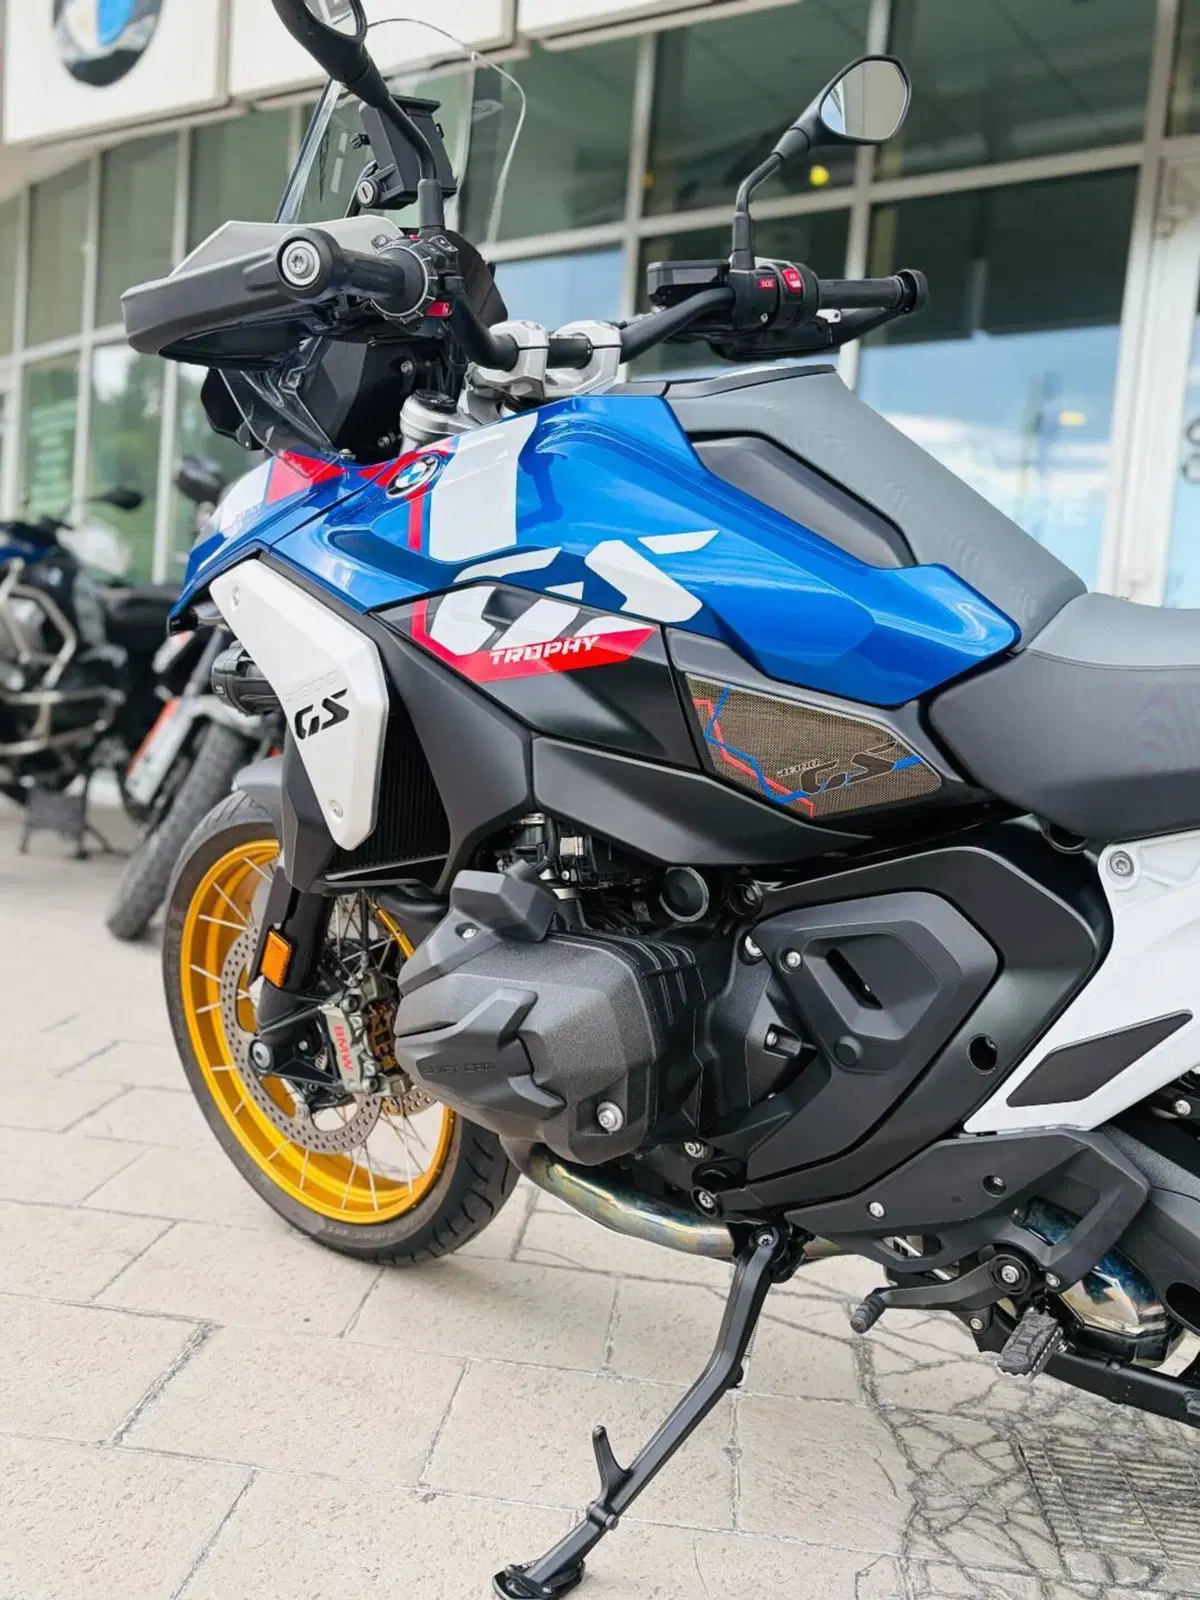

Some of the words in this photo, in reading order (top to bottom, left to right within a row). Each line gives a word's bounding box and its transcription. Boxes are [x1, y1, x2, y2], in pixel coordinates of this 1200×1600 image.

[489, 635, 600, 665] TROPHY
[294, 688, 349, 740] GS
[800, 740, 898, 794] GS
[334, 1025, 354, 1074] BMW
